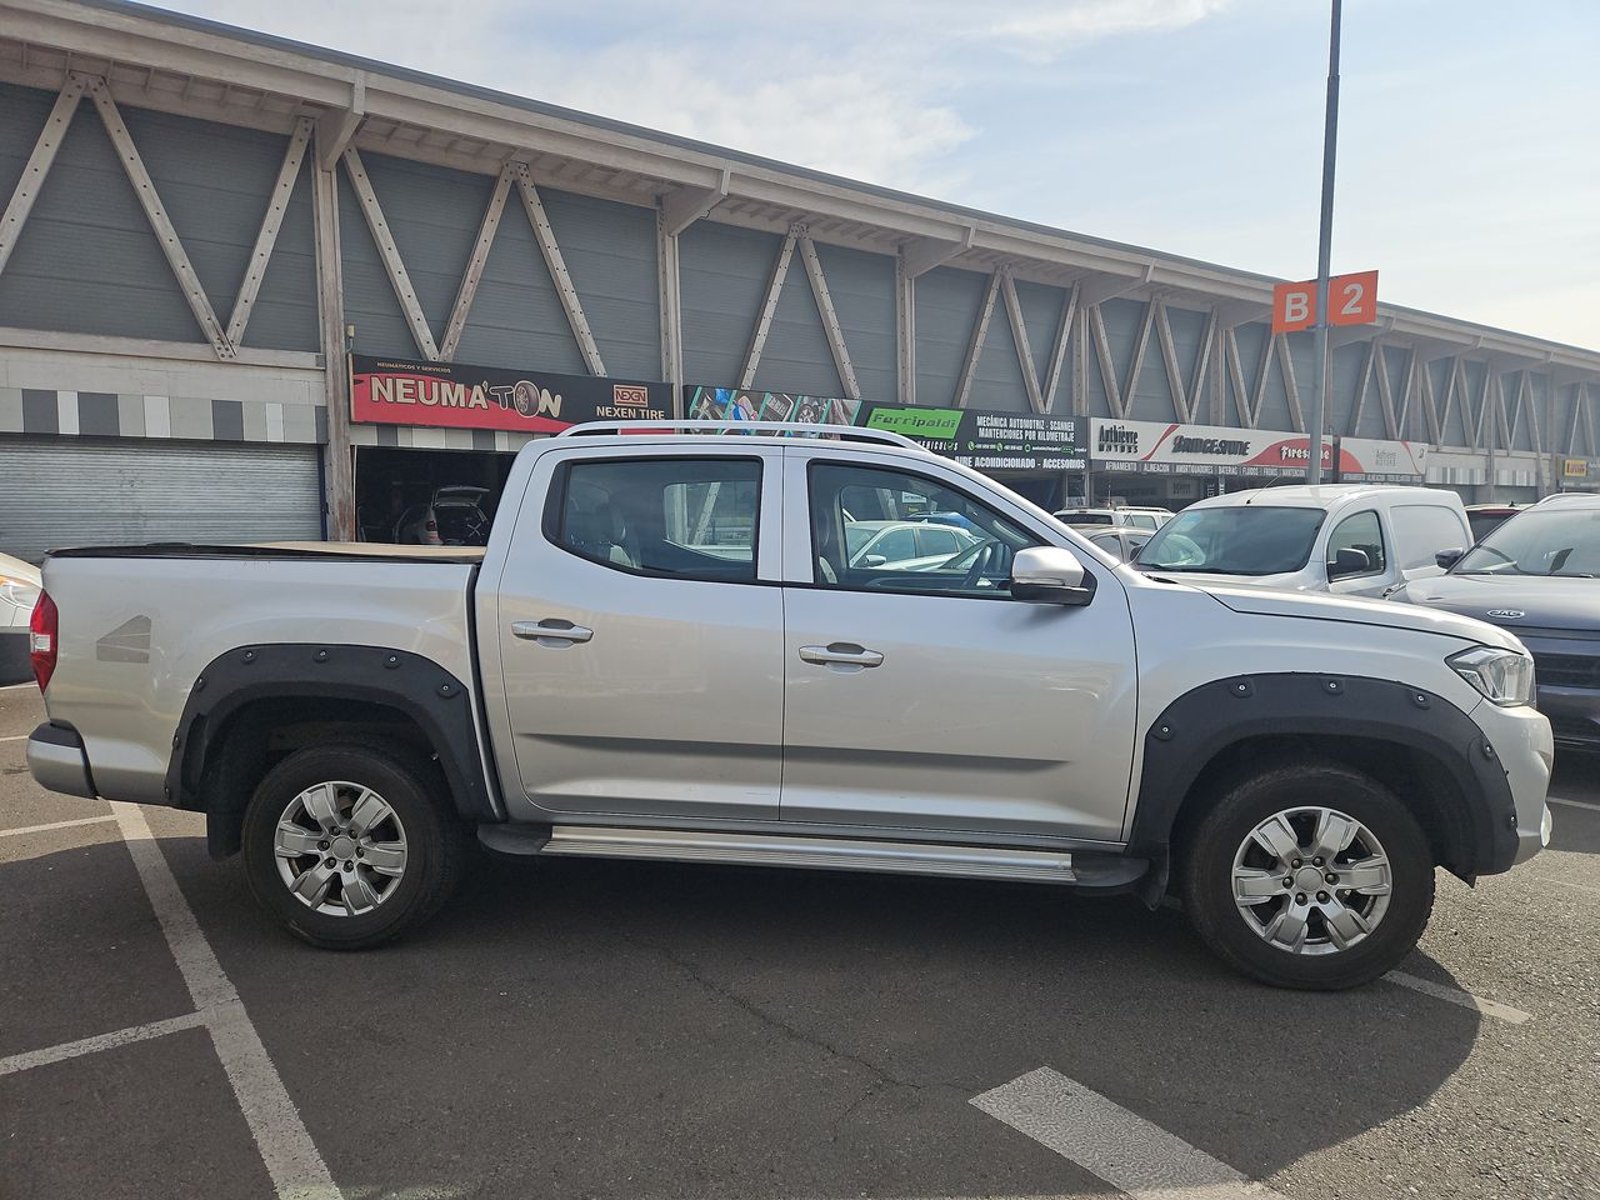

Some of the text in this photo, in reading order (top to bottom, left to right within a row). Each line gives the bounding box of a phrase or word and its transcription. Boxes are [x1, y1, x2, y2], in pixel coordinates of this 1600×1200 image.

[1341, 283, 1363, 315] 2
[1285, 292, 1309, 323] B
[615, 390, 646, 402] NEXEN
[596, 405, 665, 420] NEXEN TIRE
[873, 413, 956, 428] Ferripaldi
[1009, 418, 1045, 430] AUTOMOTRIZ
[1050, 420, 1075, 432] SCANNER
[978, 427, 1075, 442] MANTENCIONES POR KILOMETRAJE
[1098, 444, 1139, 454] MOTORS
[1172, 435, 1251, 456] BRIDGESTONE
[974, 457, 1036, 468] ACONDICIONADO
[1042, 458, 1086, 469] ACCESORIOS
